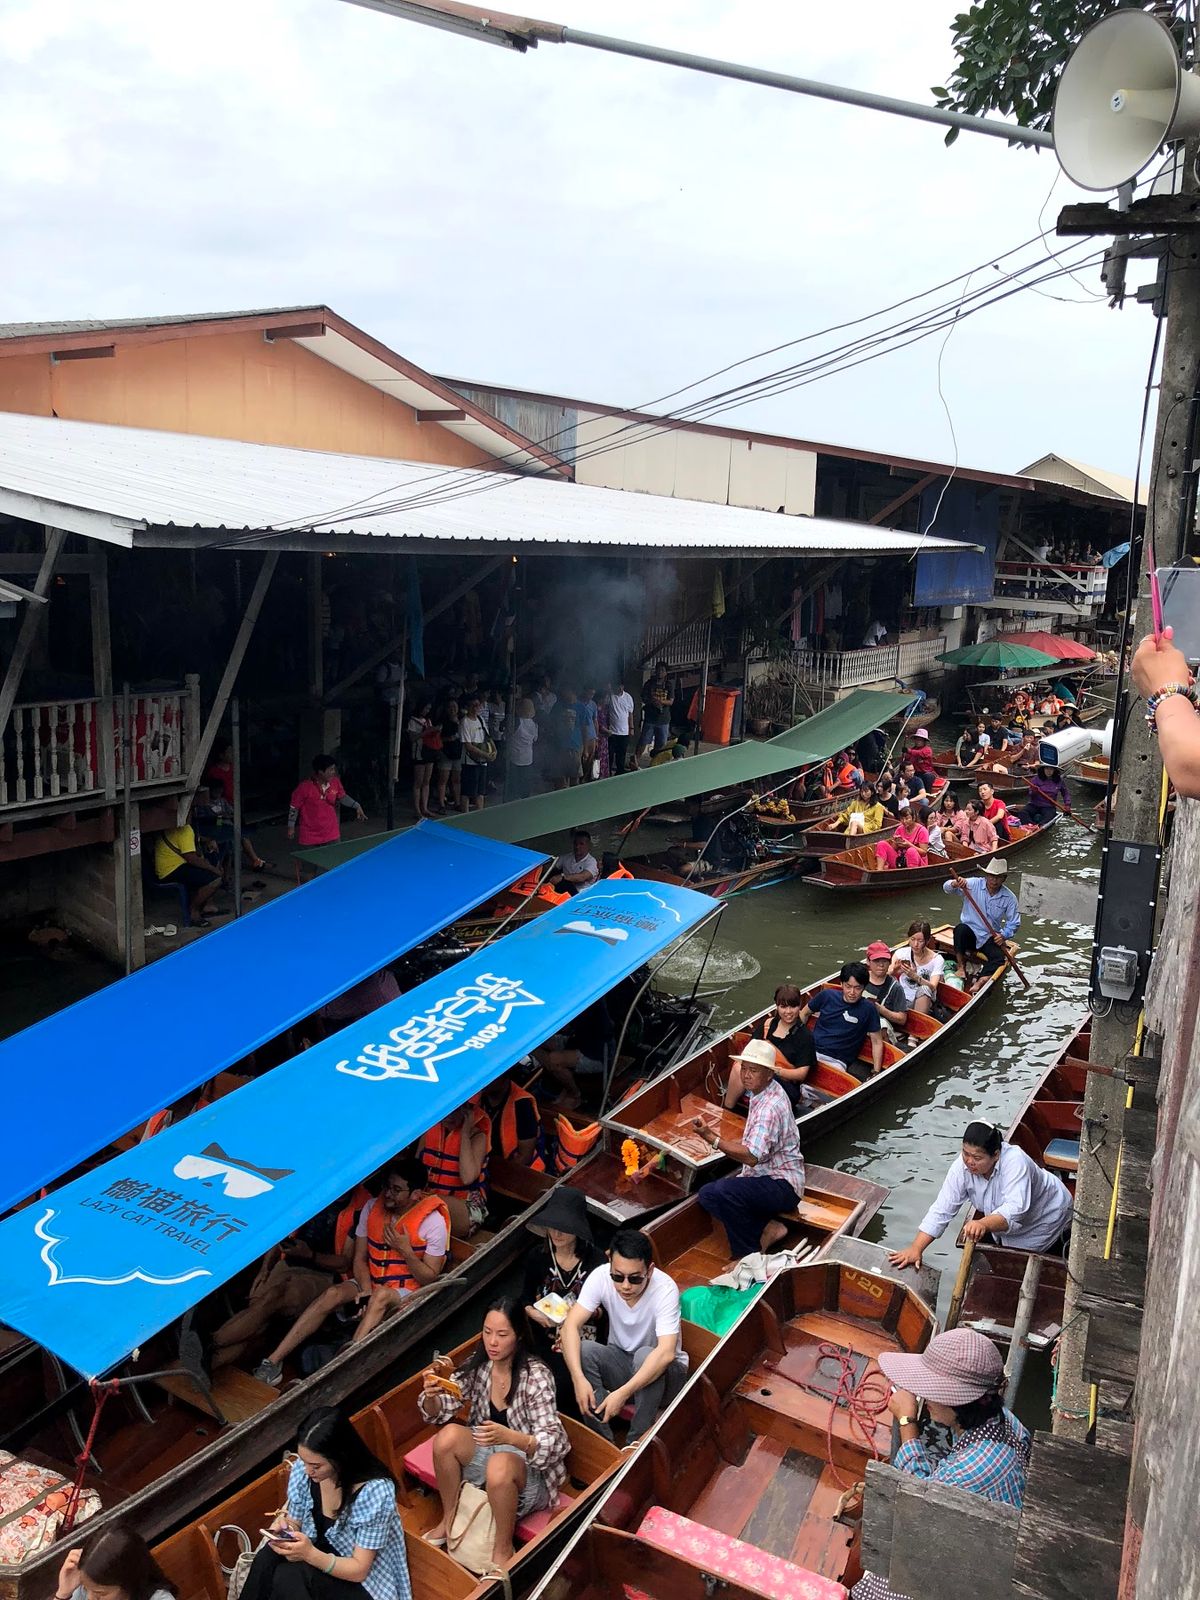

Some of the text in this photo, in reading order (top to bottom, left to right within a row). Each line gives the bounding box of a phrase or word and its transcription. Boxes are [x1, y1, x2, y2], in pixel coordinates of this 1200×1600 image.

[464, 1023, 507, 1049] 2018
[79, 1197, 212, 1256] LAZY CAT TRAVEL
[100, 1177, 249, 1242] 懒猫旅行
